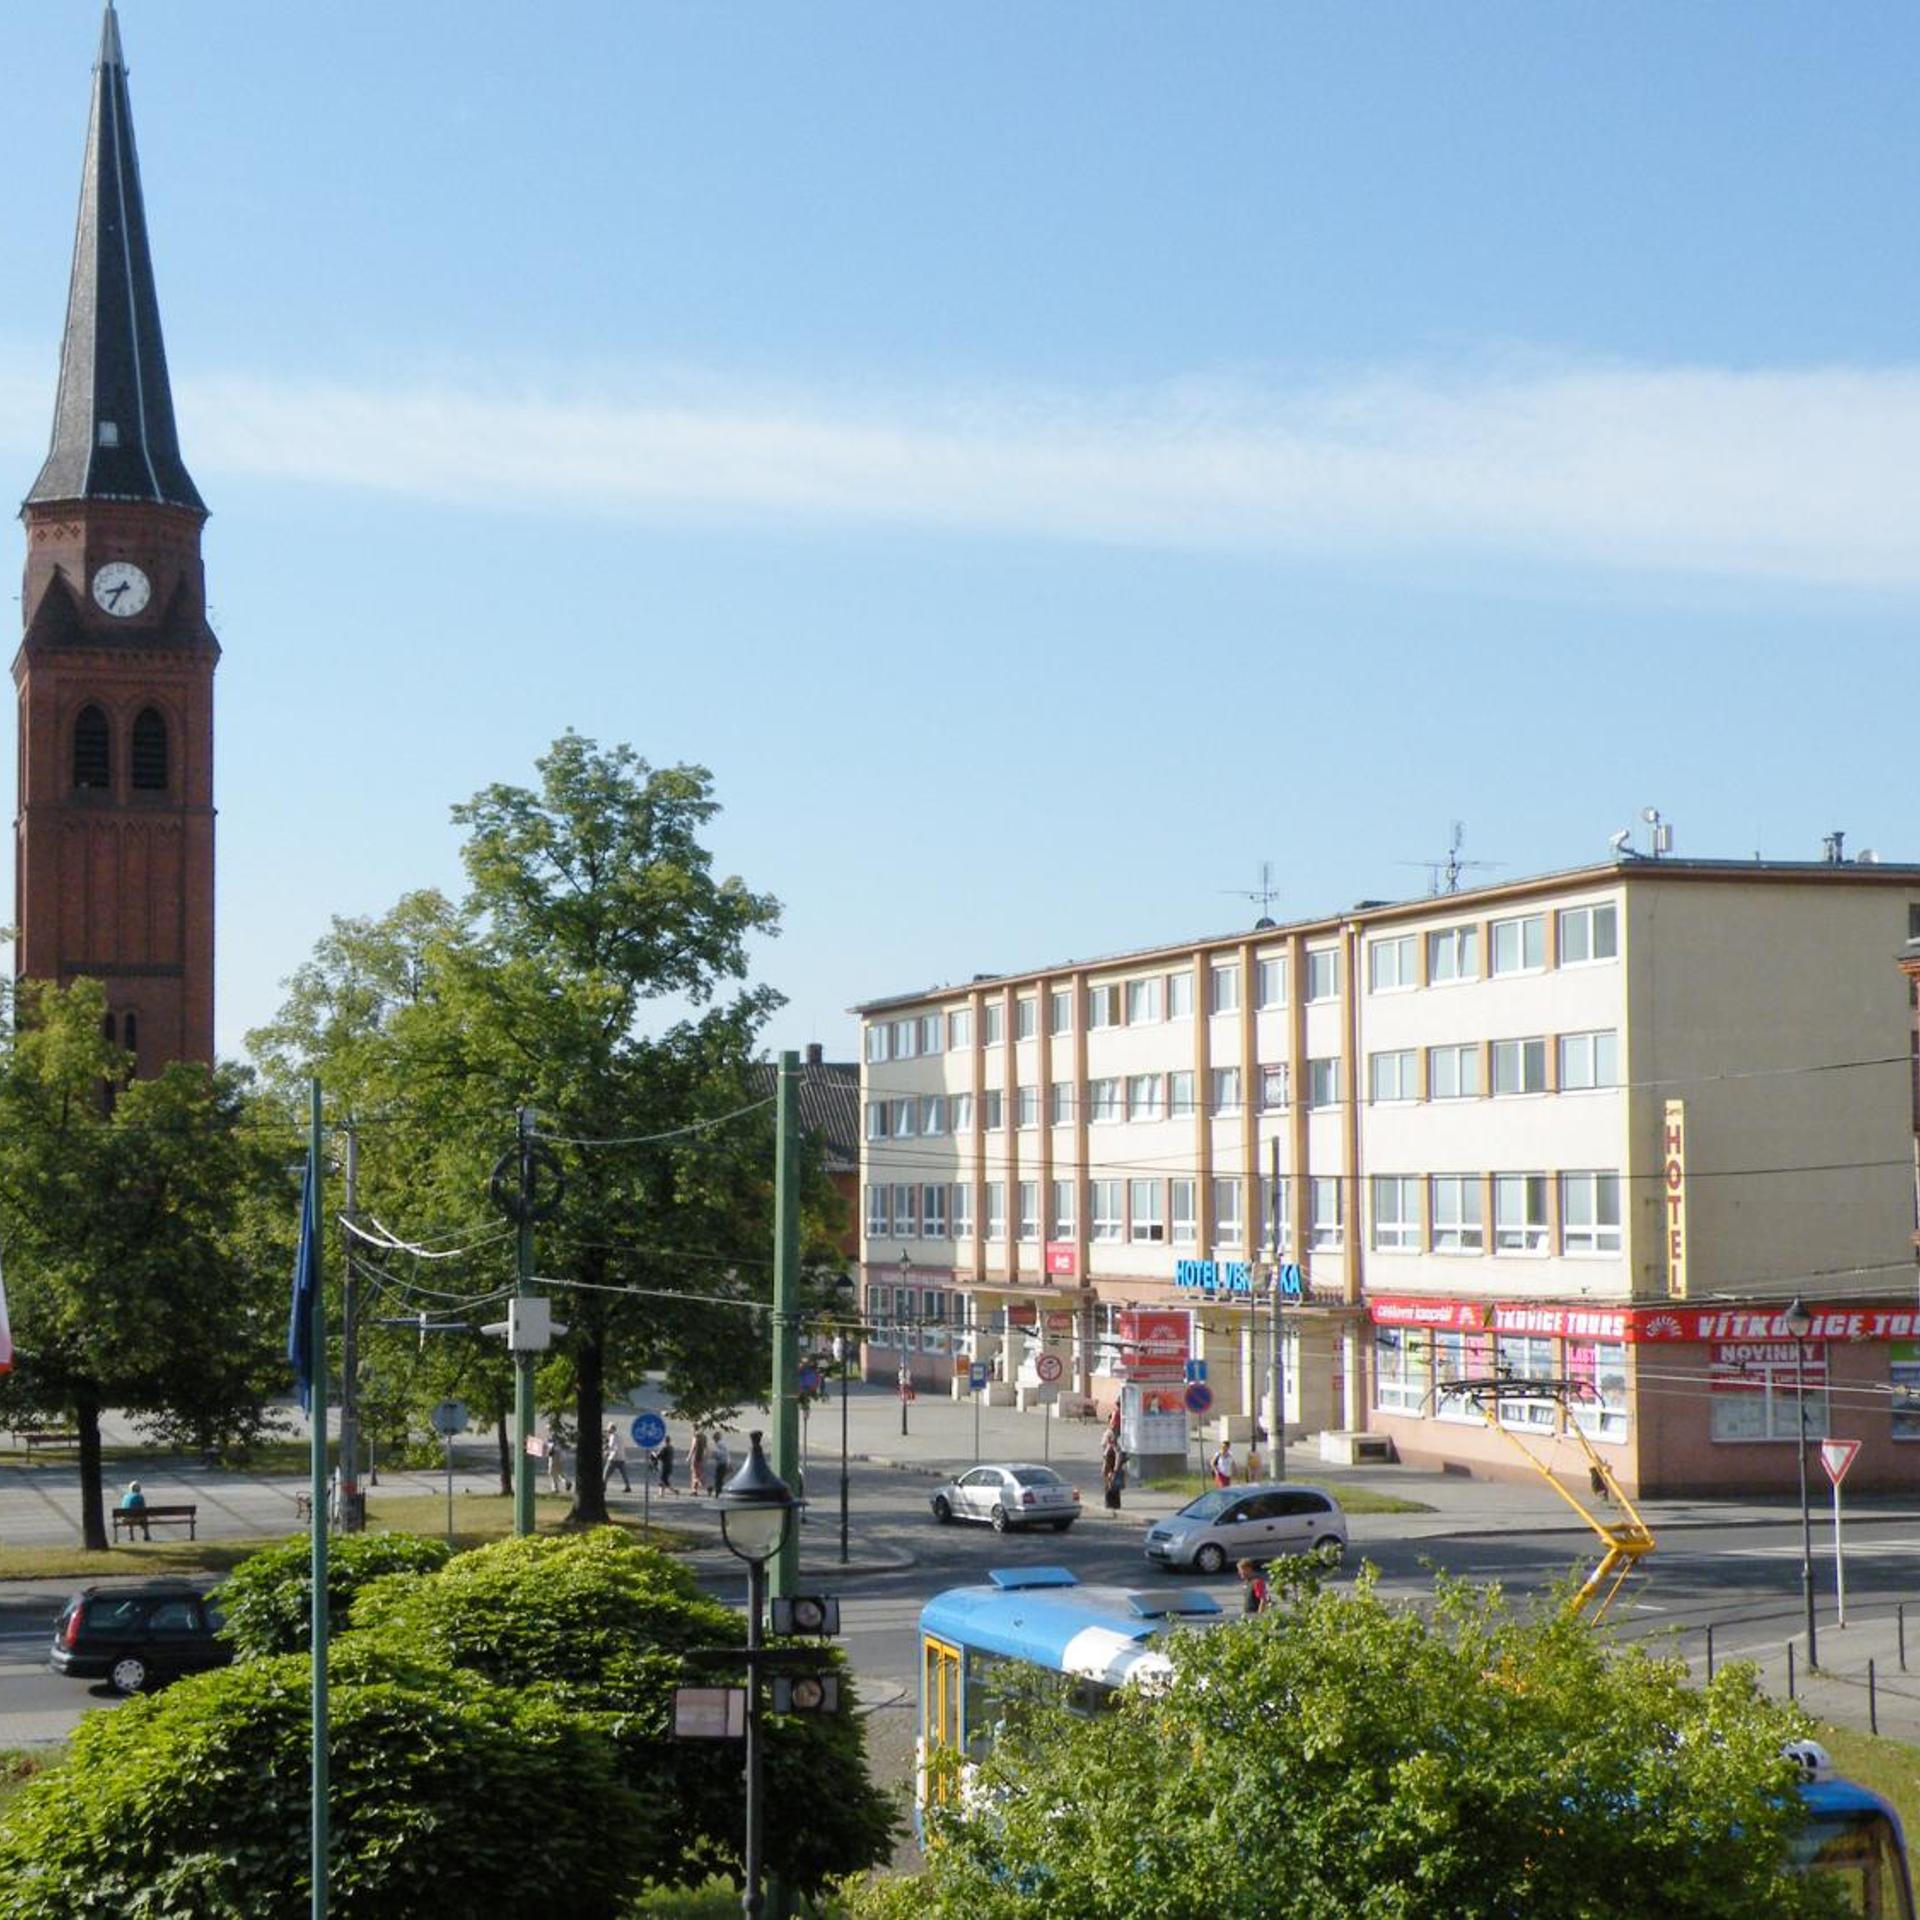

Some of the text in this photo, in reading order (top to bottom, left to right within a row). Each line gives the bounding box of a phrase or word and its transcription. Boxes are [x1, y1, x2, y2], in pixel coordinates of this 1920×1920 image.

[1665, 1124, 1682, 1294] HOTEL
[1174, 1259, 1219, 1291] HOTEL
[1697, 1308, 1864, 1338] VÍTKOICE
